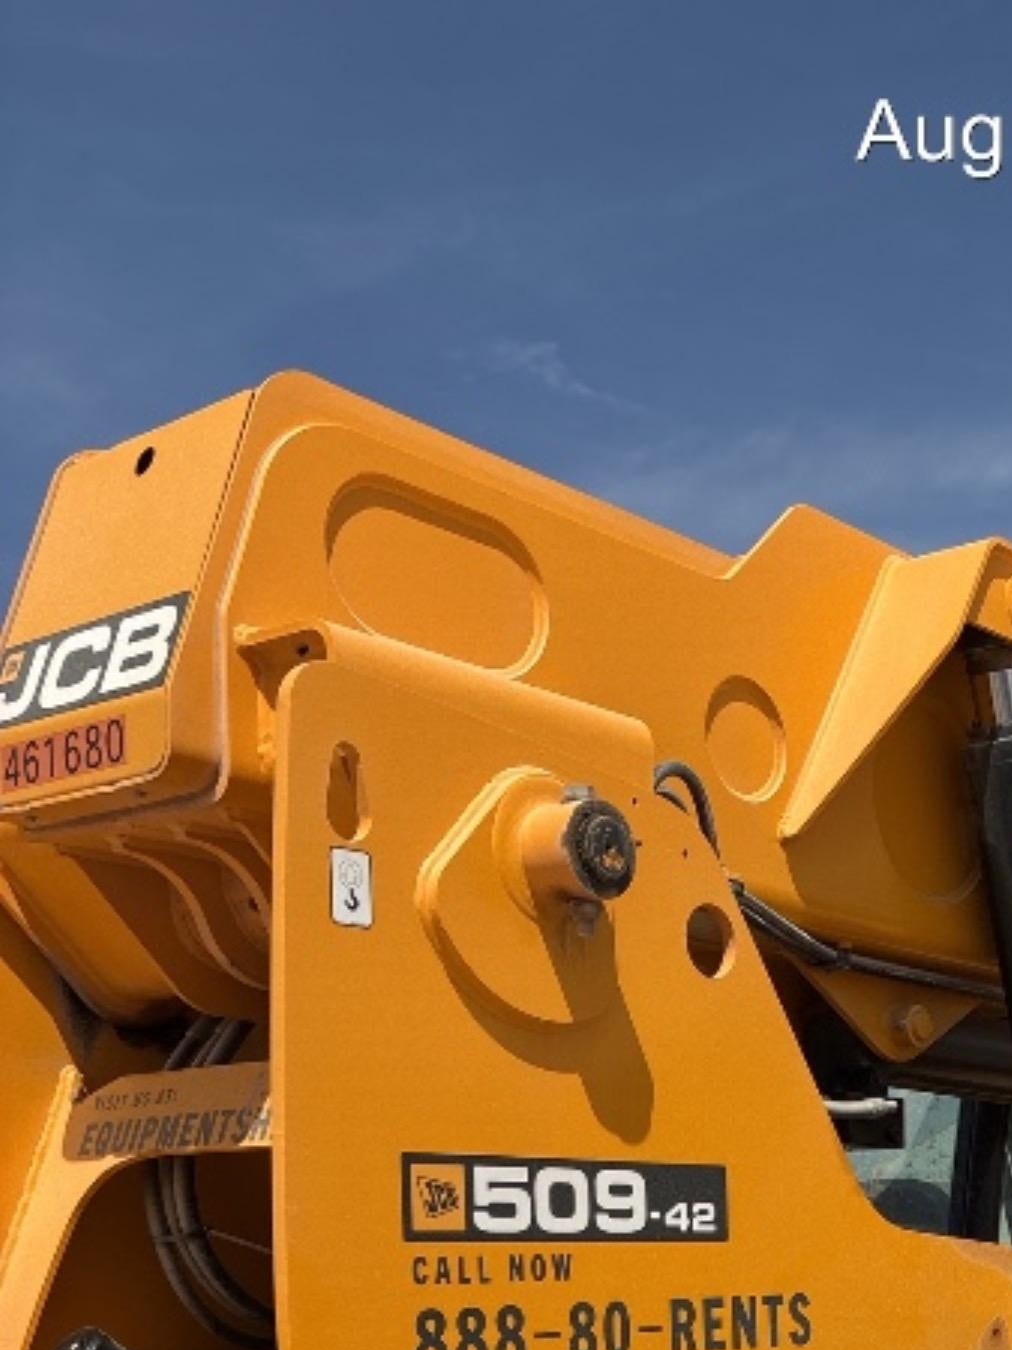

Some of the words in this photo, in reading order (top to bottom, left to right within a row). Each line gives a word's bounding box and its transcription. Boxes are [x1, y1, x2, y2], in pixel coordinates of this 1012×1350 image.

[0, 604, 178, 723] JCB
[4, 718, 125, 787] 461680
[472, 1165, 718, 1235] 509-42
[412, 1255, 491, 1285] CALL
[508, 1253, 572, 1282] NOW
